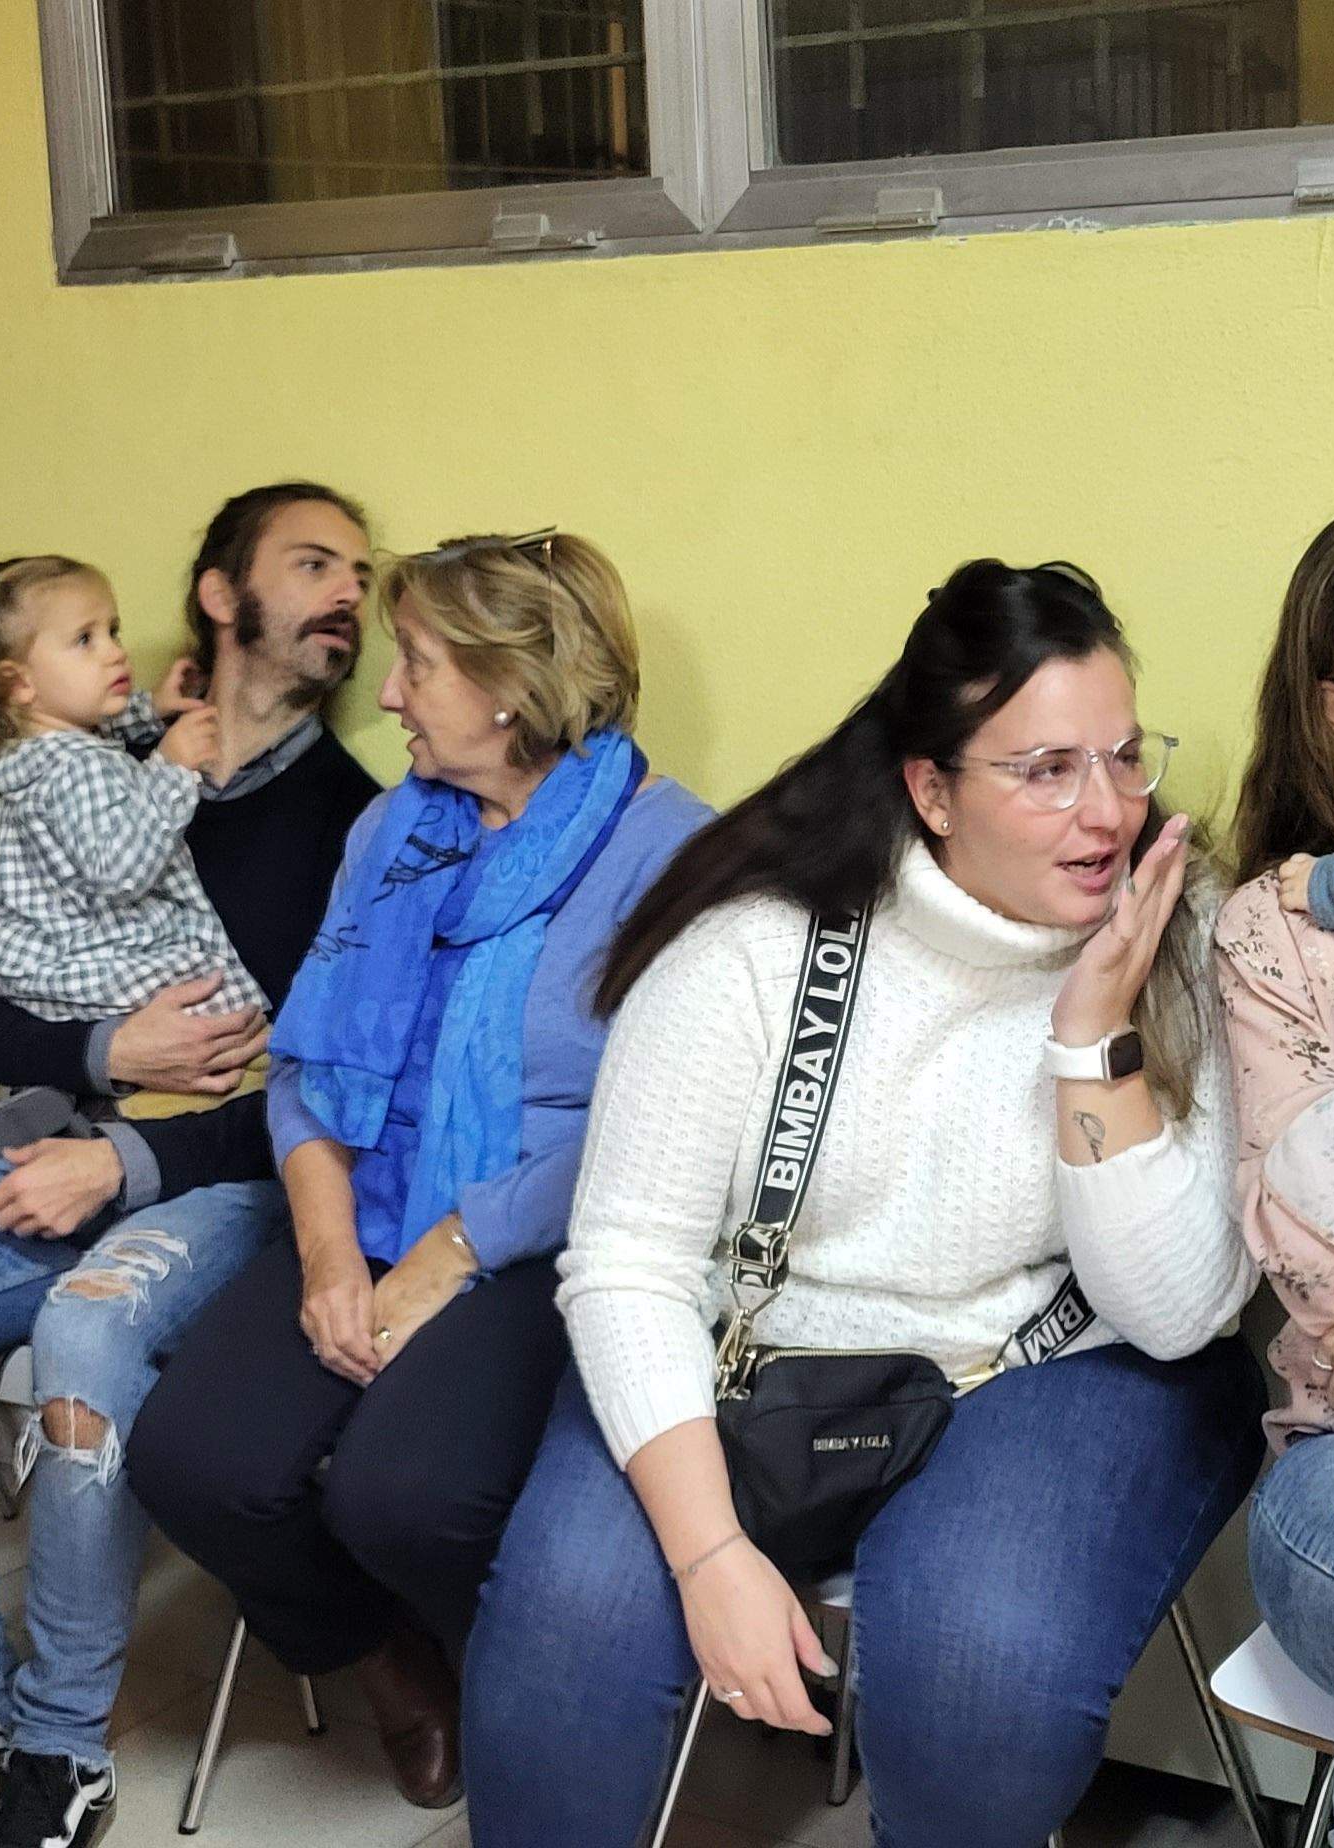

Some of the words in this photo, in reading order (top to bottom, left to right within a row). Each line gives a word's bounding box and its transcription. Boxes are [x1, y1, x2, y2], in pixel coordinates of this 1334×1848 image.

[810, 910, 860, 1002] LOL
[798, 1007, 838, 1039] Y
[765, 1048, 832, 1191] BIMBA
